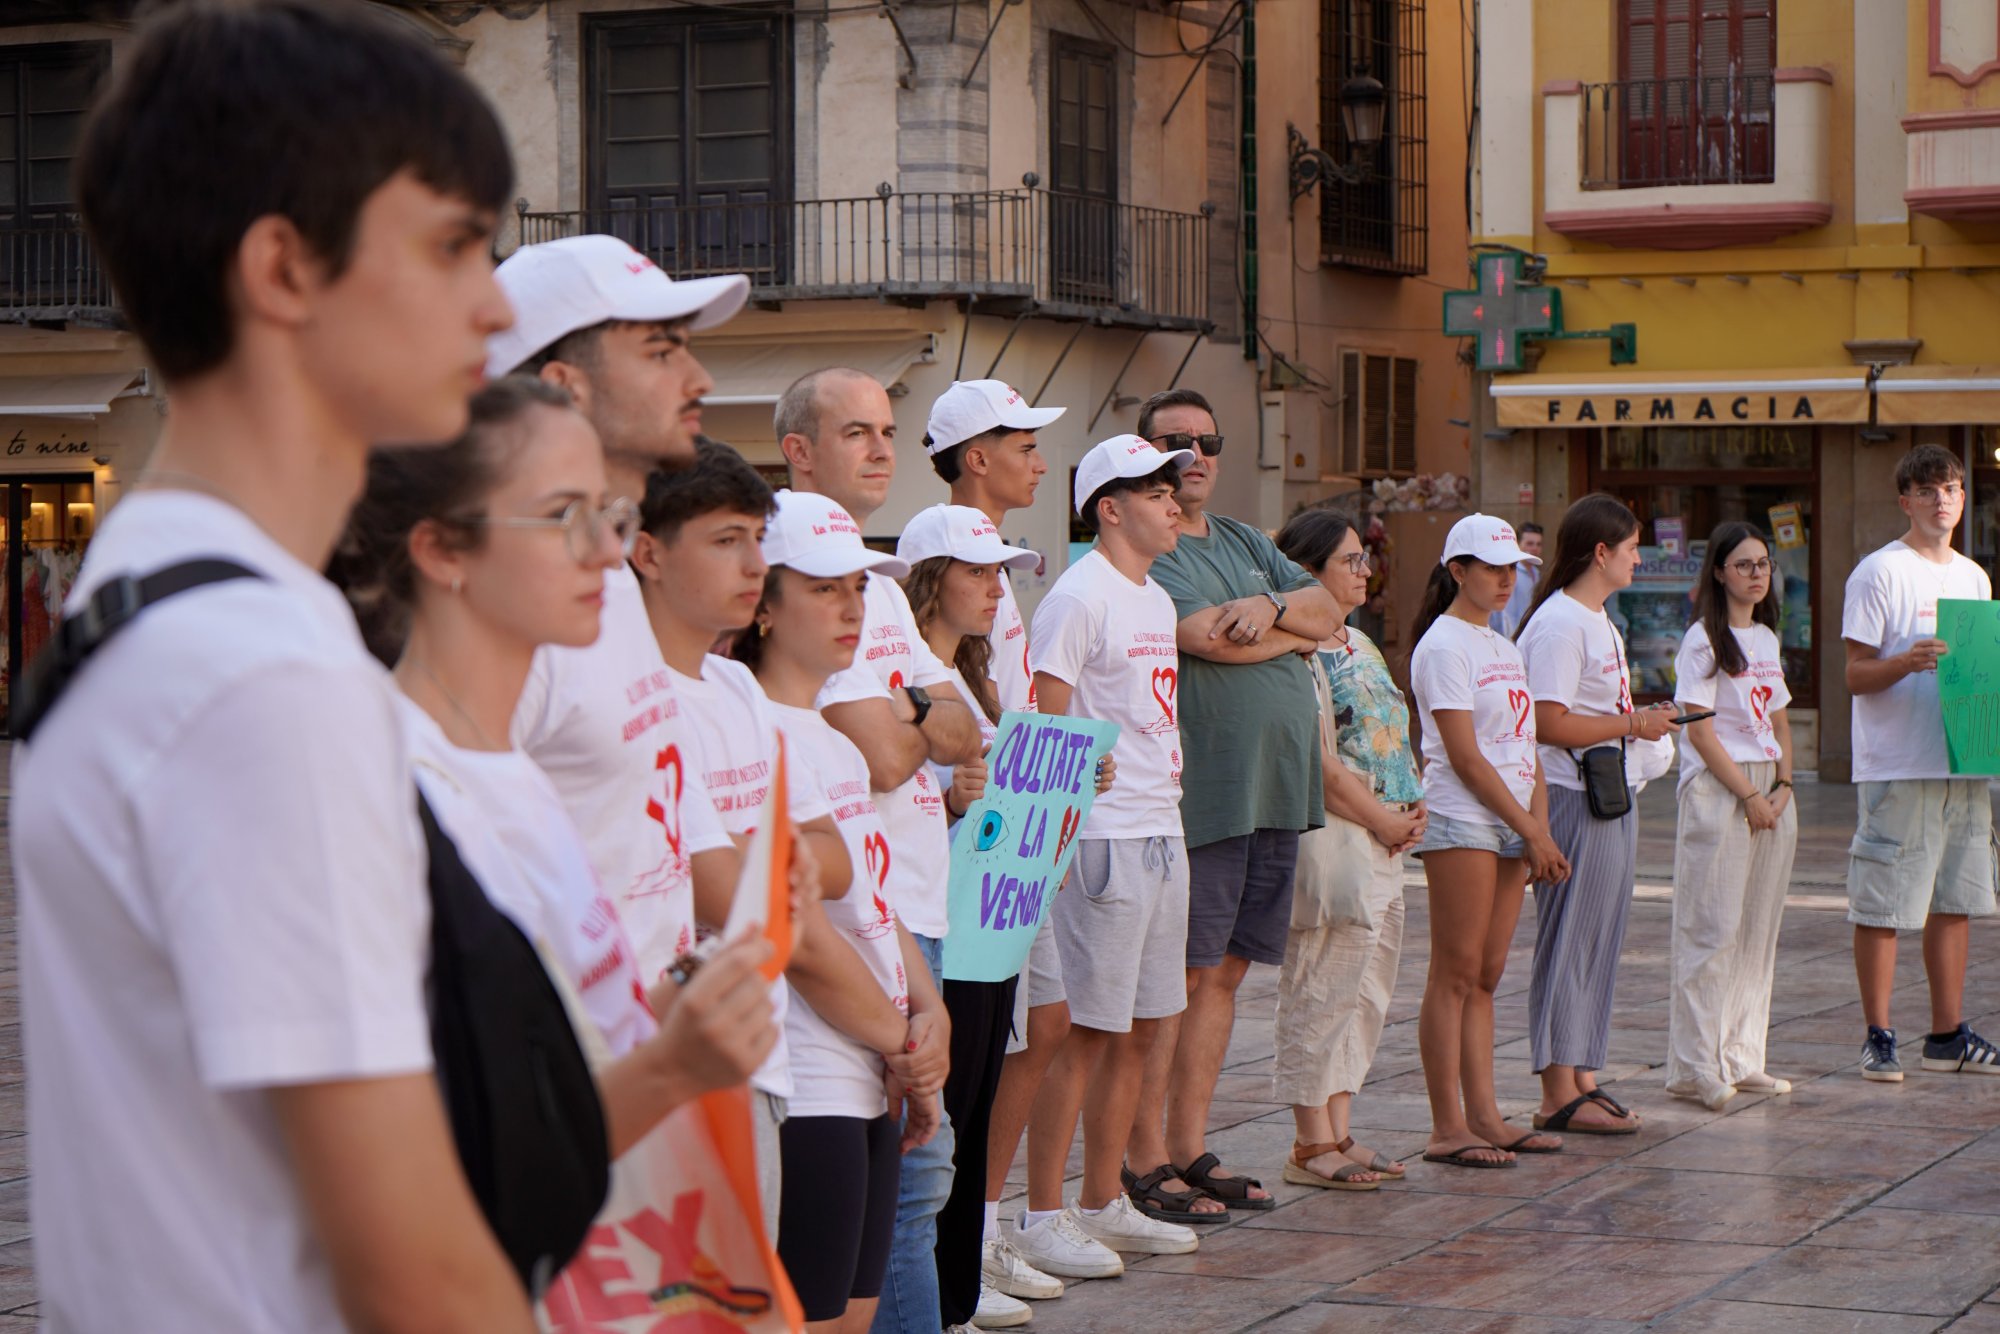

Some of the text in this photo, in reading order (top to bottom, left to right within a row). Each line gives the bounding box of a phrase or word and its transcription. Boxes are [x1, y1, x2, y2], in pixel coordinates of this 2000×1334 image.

[1548, 397, 1814, 421] FARMACIA
[7, 429, 91, 456] to nine
[812, 525, 827, 535] la
[972, 528, 983, 536] la
[1969, 657, 1989, 685] los
[1018, 804, 1047, 858] LA
[981, 872, 1046, 930] VENDA
